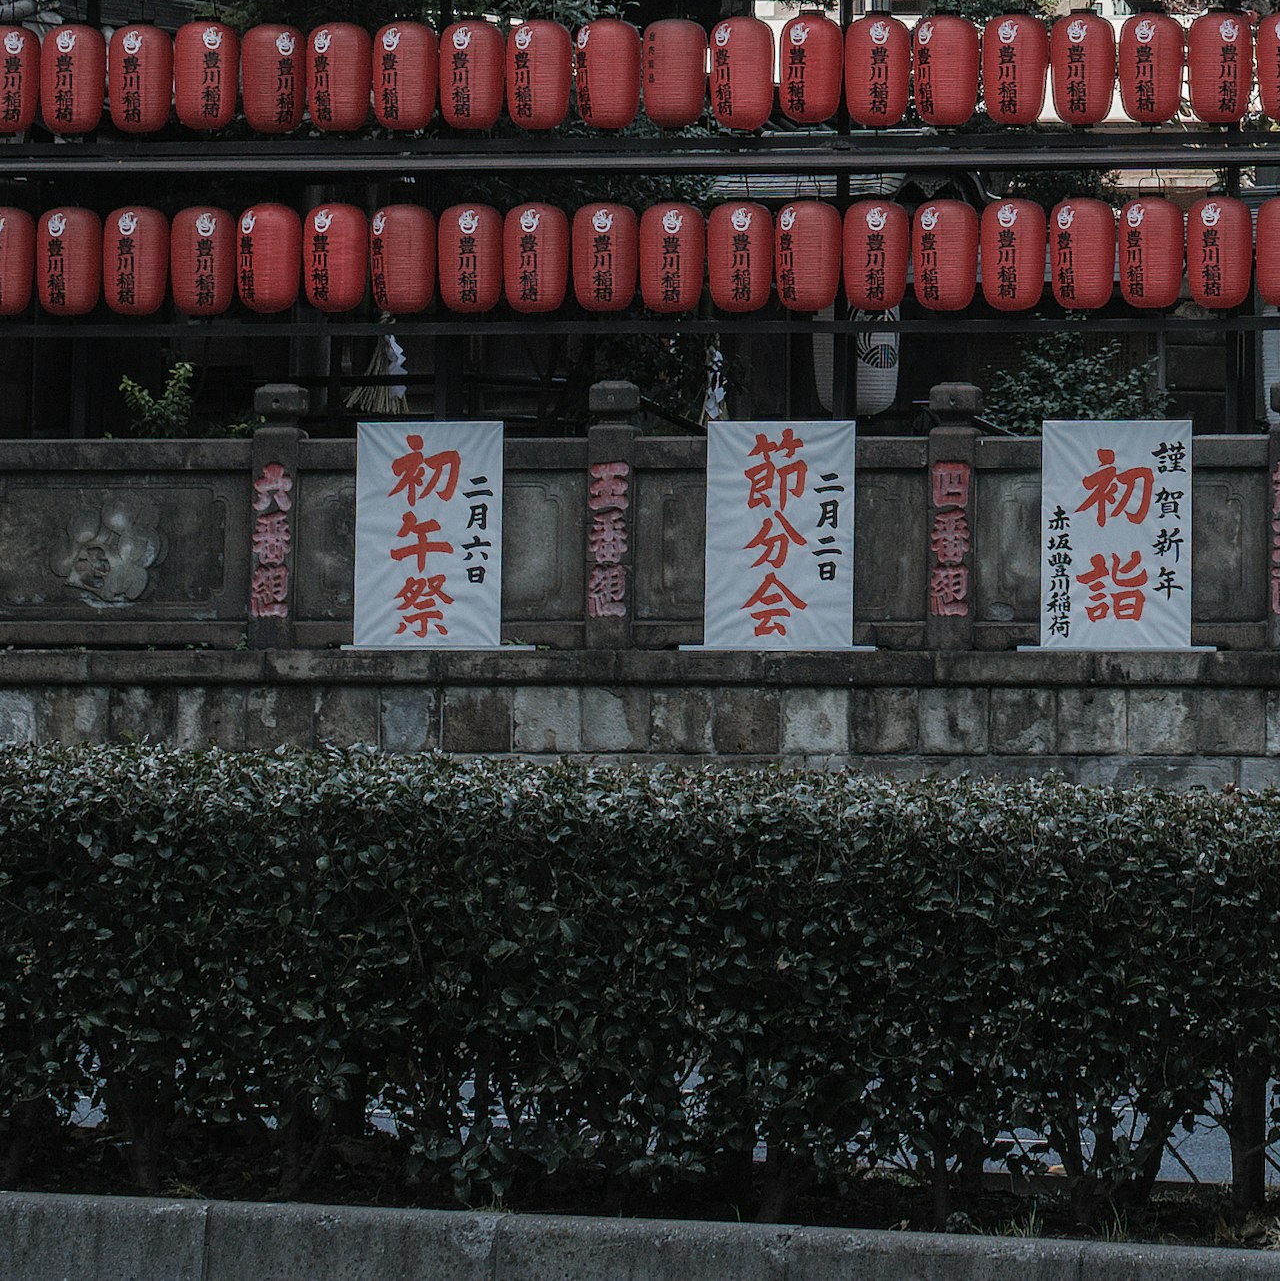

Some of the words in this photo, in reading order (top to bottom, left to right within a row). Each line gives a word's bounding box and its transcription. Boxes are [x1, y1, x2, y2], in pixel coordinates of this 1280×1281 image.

[2, 55, 23, 123] 豊川稲荷
[55, 54, 73, 123] 豊川稲荷
[122, 55, 141, 123] 豊川稲荷
[201, 52, 221, 118] 豊川稲荷
[275, 57, 295, 125] 豊川稲荷
[314, 53, 332, 122] 豊川稲荷
[382, 53, 399, 120] 豊川稲荷
[451, 51, 470, 118] 豊川稲荷
[515, 51, 532, 118] 豊川稲荷
[715, 46, 732, 117] 豊川稲荷
[787, 46, 807, 114] 豊川稲荷
[869, 46, 889, 115] 豊川稲荷
[917, 47, 934, 115] 豊川稲荷
[997, 45, 1018, 114] 豊川稲荷
[1067, 44, 1086, 114] 豊川稲荷
[1135, 44, 1155, 114] 豊川稲荷
[1218, 43, 1239, 114] 豊川稲荷
[47, 238, 66, 306] 豊川稲荷
[116, 237, 135, 305] 豊川稲荷
[195, 239, 216, 306] 豊川稲荷
[239, 234, 256, 302] 豊川稲荷
[311, 234, 329, 302] 豊川稲荷
[458, 236, 477, 303] 豊川稲荷
[520, 234, 538, 302] 豊川稲荷
[592, 234, 612, 302] 豊川稲荷
[661, 236, 681, 303] 豊川稲荷
[731, 234, 751, 302] 豊川稲荷
[779, 233, 797, 302] 豊川稲荷
[866, 233, 885, 301] 豊川稲荷
[920, 233, 938, 301] 豊川稲荷
[997, 230, 1016, 299] 豊川稲荷
[1057, 232, 1075, 300] 豊川稲荷
[1126, 230, 1144, 298] 豊川稲荷
[1202, 229, 1220, 297] 豊川稲荷
[251, 461, 292, 618] 六番組
[388, 435, 461, 638] 初午祭
[461, 476, 494, 584] 二月六日
[588, 461, 629, 618] 五番組
[740, 428, 808, 636] 節分会
[812, 473, 844, 581] 二月二日
[931, 460, 970, 616] 四番組
[1074, 448, 1154, 622] 初詣
[1151, 441, 1187, 600] 謹賀新年
